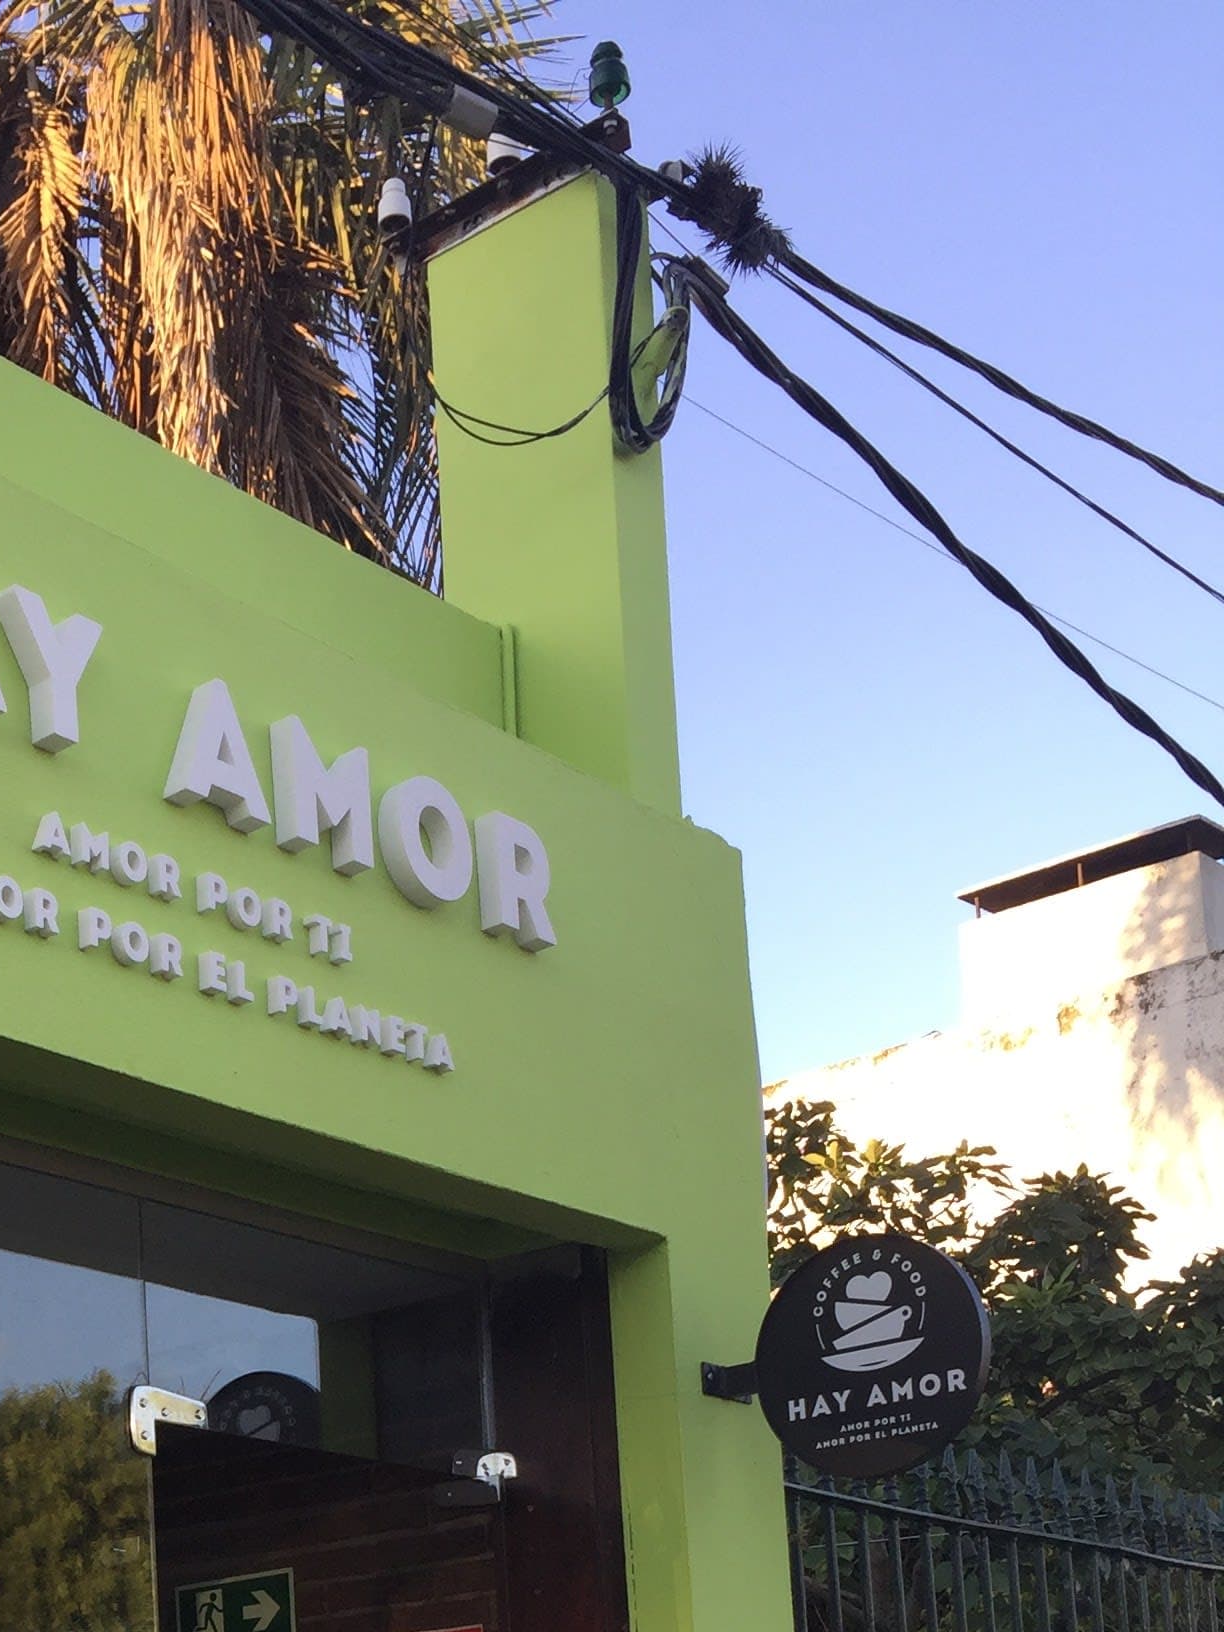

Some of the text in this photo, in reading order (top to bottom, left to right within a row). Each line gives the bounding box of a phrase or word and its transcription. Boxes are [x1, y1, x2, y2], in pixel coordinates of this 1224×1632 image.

[163, 677, 559, 954] AMOR
[31, 810, 354, 966] AMOR POR TI
[77, 906, 184, 980] POR
[197, 949, 255, 1005] EL
[266, 974, 456, 1075] PLANETA
[813, 1252, 862, 1317] COFFEE
[890, 1252, 927, 1298] FOOD
[787, 1368, 968, 1422] HAY AMOR
[840, 1413, 912, 1433] AMOR POR TI
[815, 1421, 940, 1450] AMOR POR EL PLANETA
